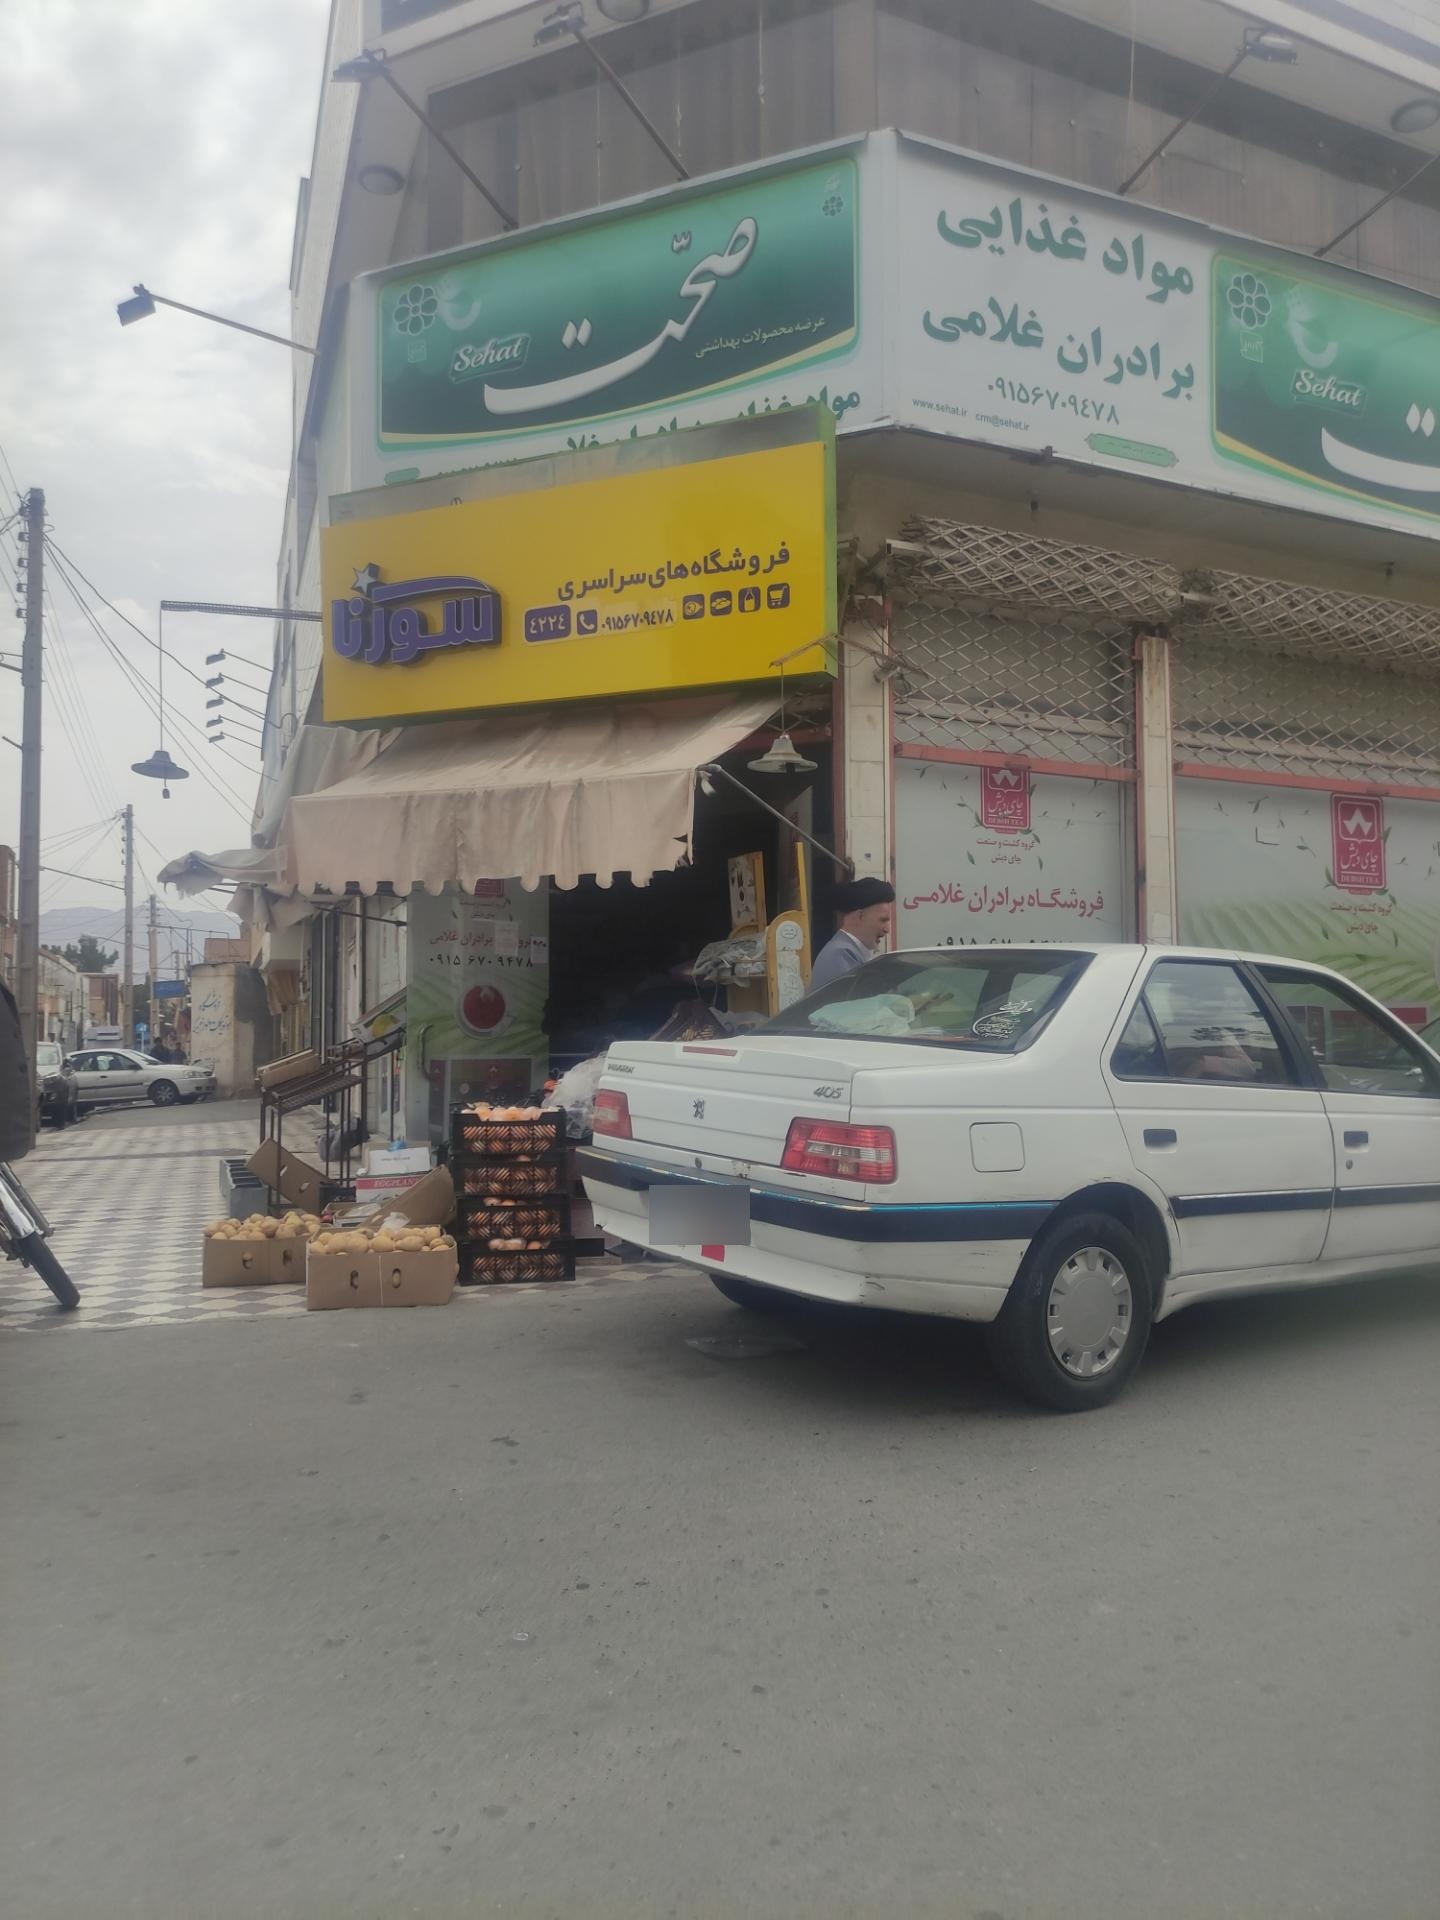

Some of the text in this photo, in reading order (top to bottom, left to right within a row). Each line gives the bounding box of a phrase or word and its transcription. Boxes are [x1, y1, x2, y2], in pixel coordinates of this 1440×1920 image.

[937, 198, 1194, 303] مواد غذایی
[695, 317, 825, 358] عرضه محصولات بهداشتی
[922, 297, 1044, 349] غلامی
[454, 338, 523, 371] Sehat
[1057, 327, 1195, 400] برادران
[1295, 369, 1361, 406] Sehat
[913, 397, 1030, 431] www.sehat.ir crm@sehat.ir
[690, 541, 790, 576] فروشگاه
[558, 568, 647, 602] سراسری
[903, 882, 1104, 918] فروشگاه برادران غلامی
[813, 1086, 844, 1099] 405
